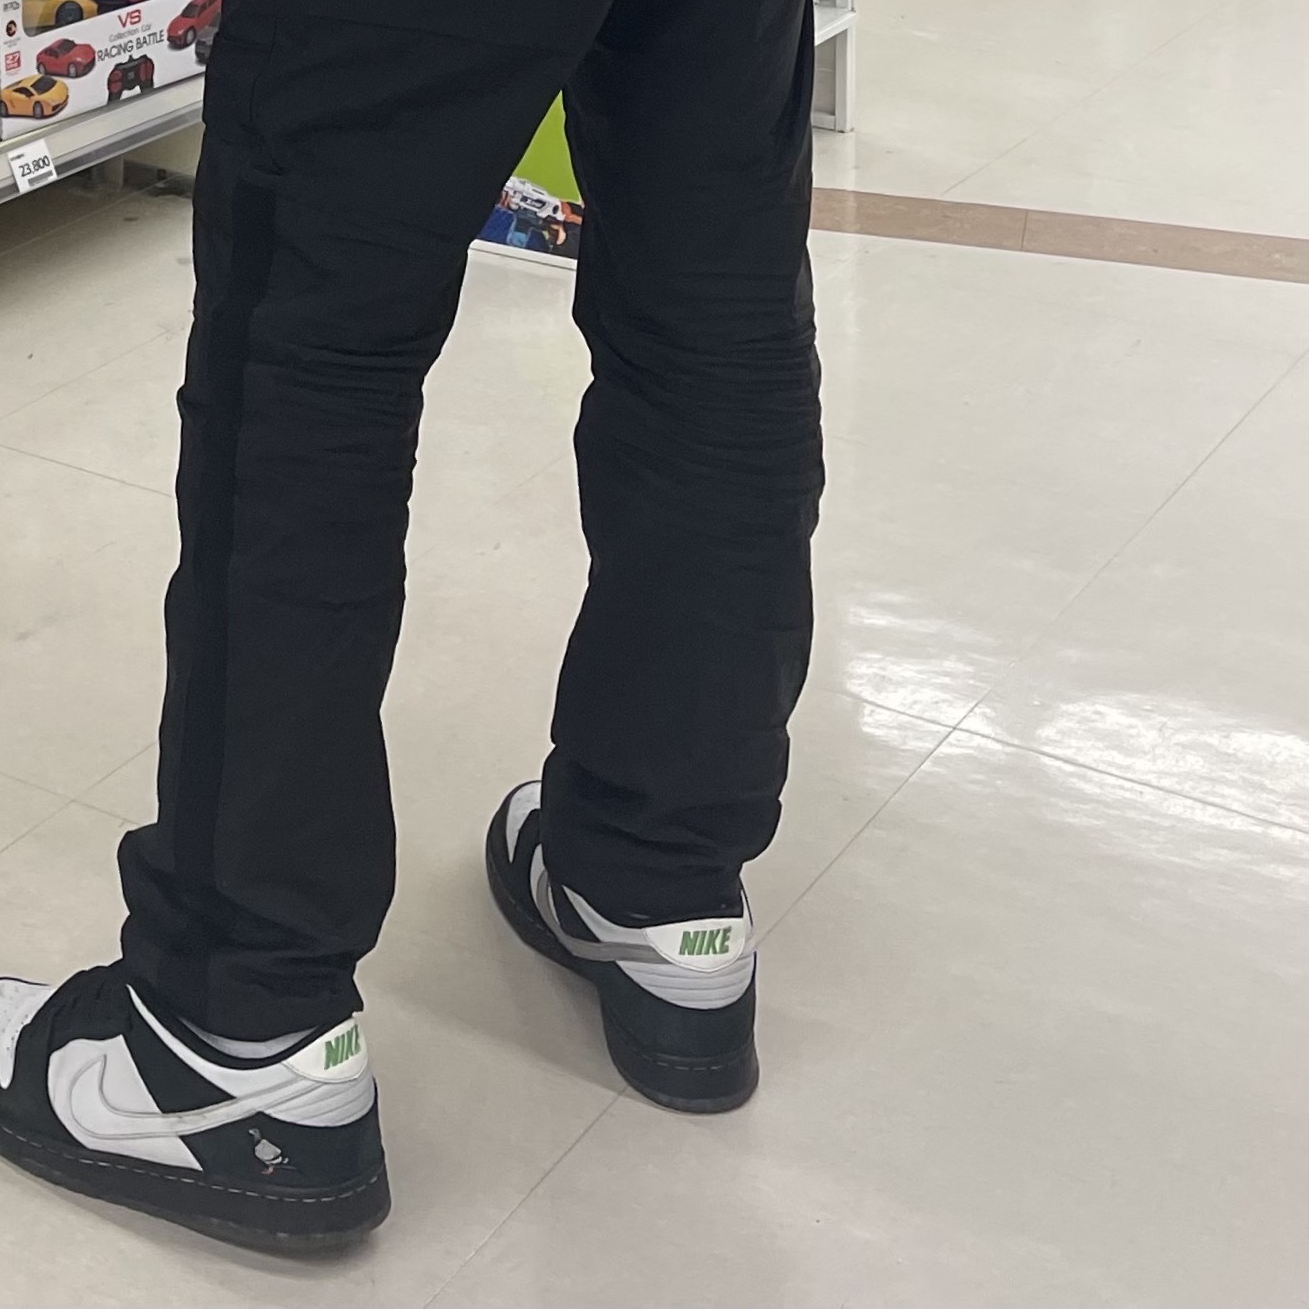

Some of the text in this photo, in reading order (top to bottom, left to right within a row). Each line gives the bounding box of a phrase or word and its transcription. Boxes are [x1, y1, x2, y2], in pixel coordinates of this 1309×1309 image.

[97, 28, 166, 63] RACING BATTLE
[18, 155, 51, 179] 23,800
[679, 926, 732, 955] NIKE
